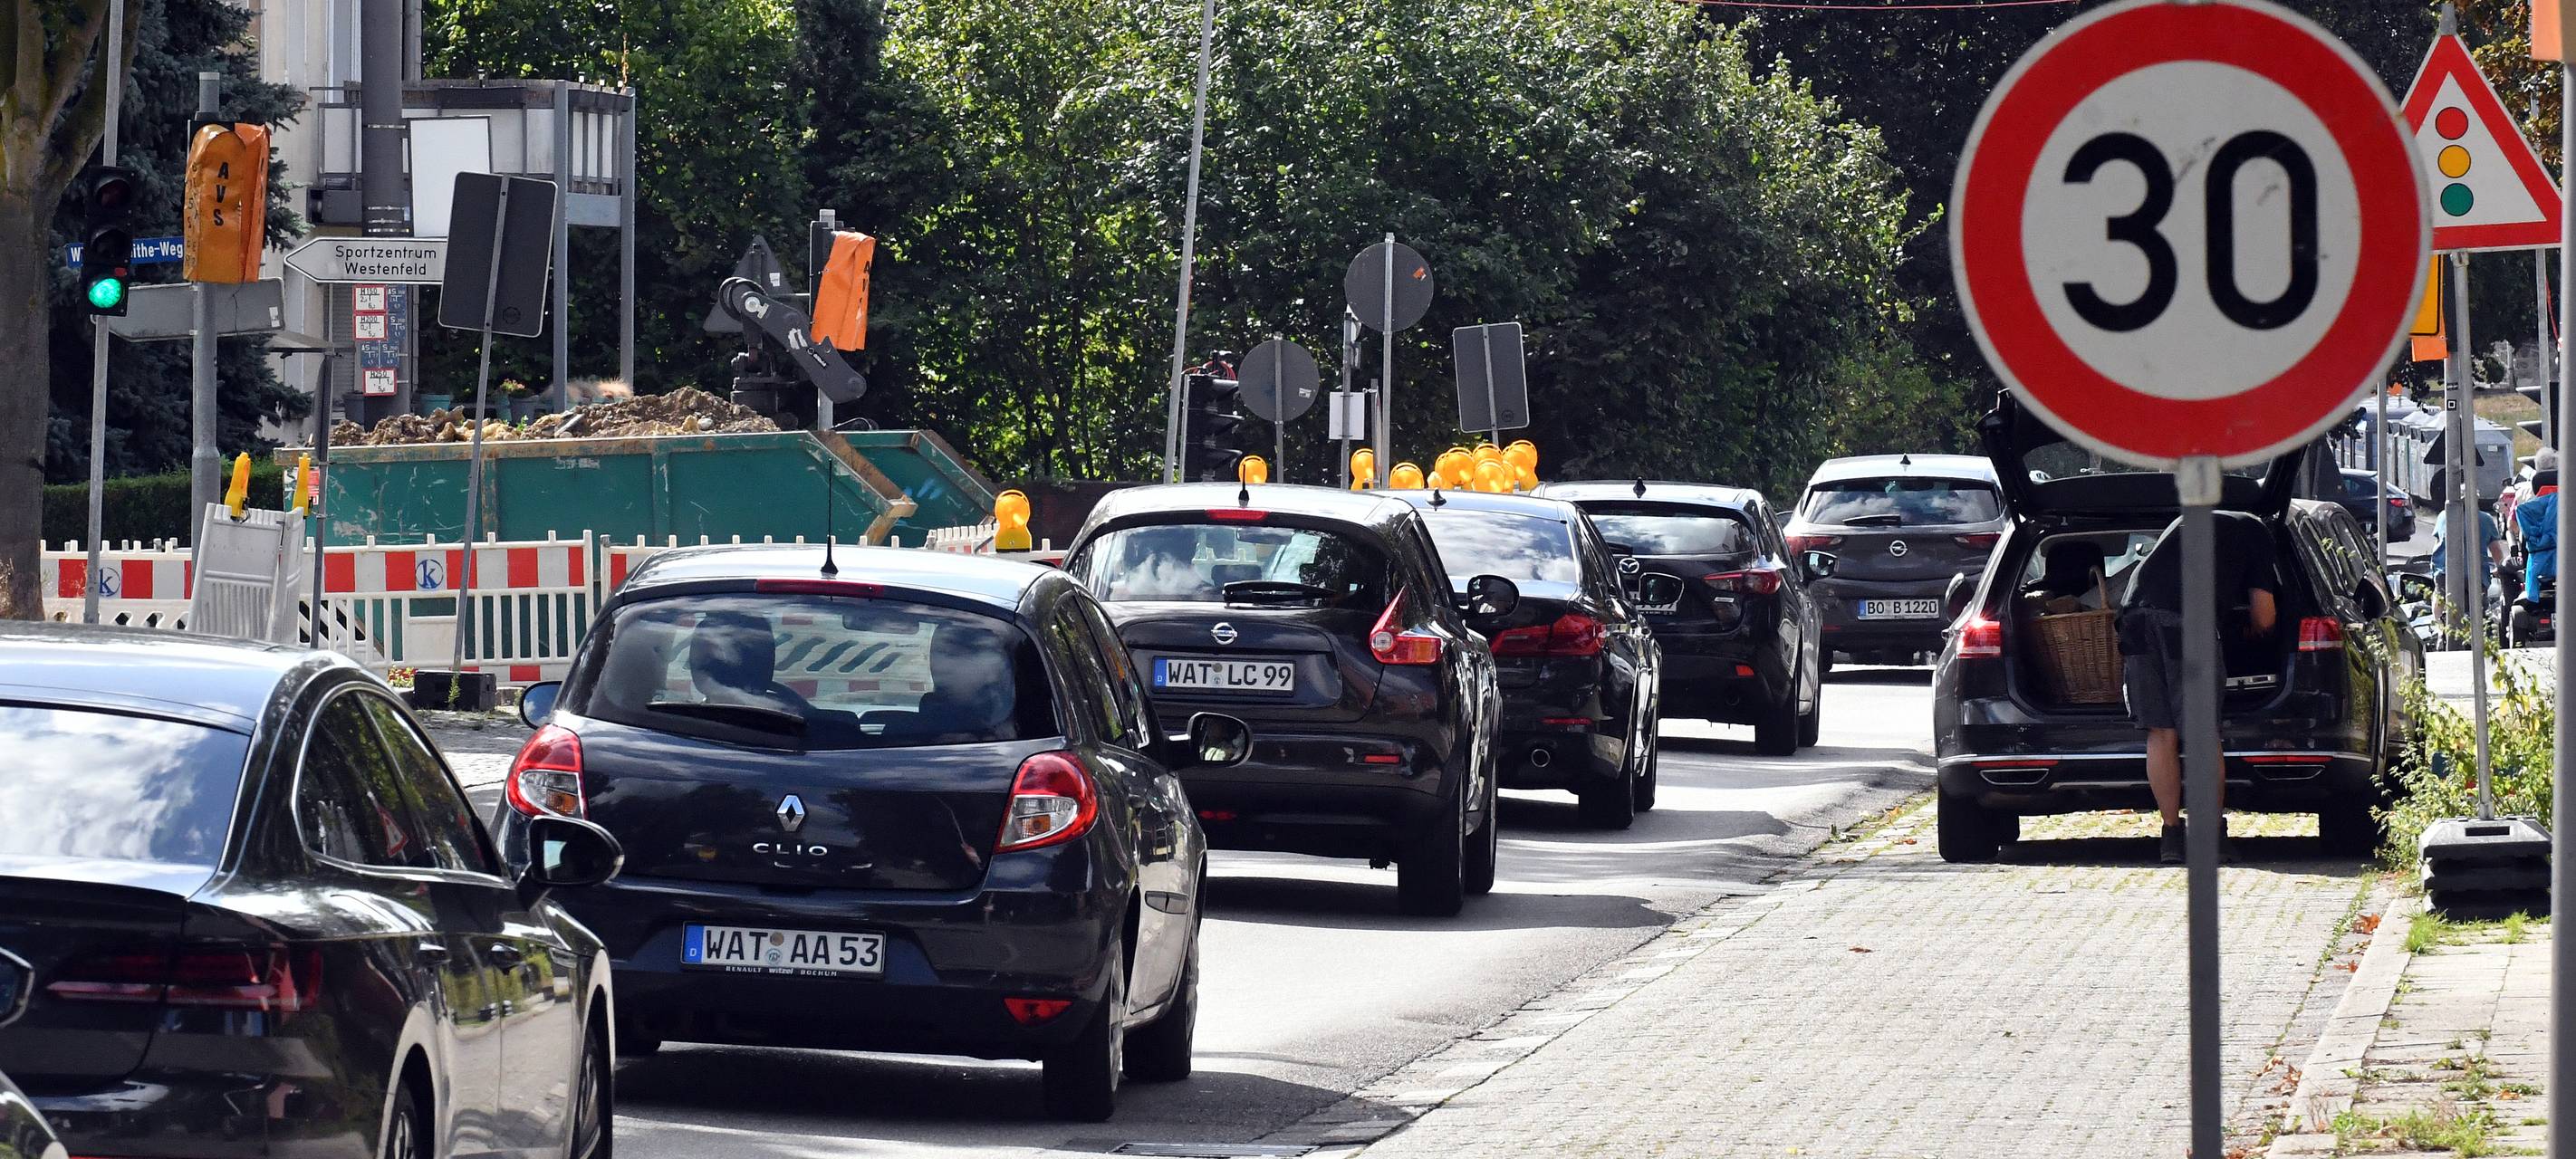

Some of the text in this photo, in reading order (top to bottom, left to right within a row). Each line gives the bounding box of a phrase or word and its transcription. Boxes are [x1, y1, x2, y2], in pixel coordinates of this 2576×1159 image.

[213, 162, 230, 226] AVS
[2062, 130, 2319, 332] 30
[335, 245, 437, 261] Sportzentrum
[345, 262, 427, 275] Westenfeld
[1868, 600, 1937, 615] BO B 1220
[1168, 662, 1212, 685] WAT
[1227, 664, 1257, 686] LC
[1264, 666, 1292, 687] 99
[753, 842, 828, 857] CLIO
[706, 929, 769, 961] WAT
[789, 934, 831, 965] AA
[839, 936, 880, 967] 53
[726, 965, 762, 973] RENAULT
[801, 969, 838, 977] BOCHUM
